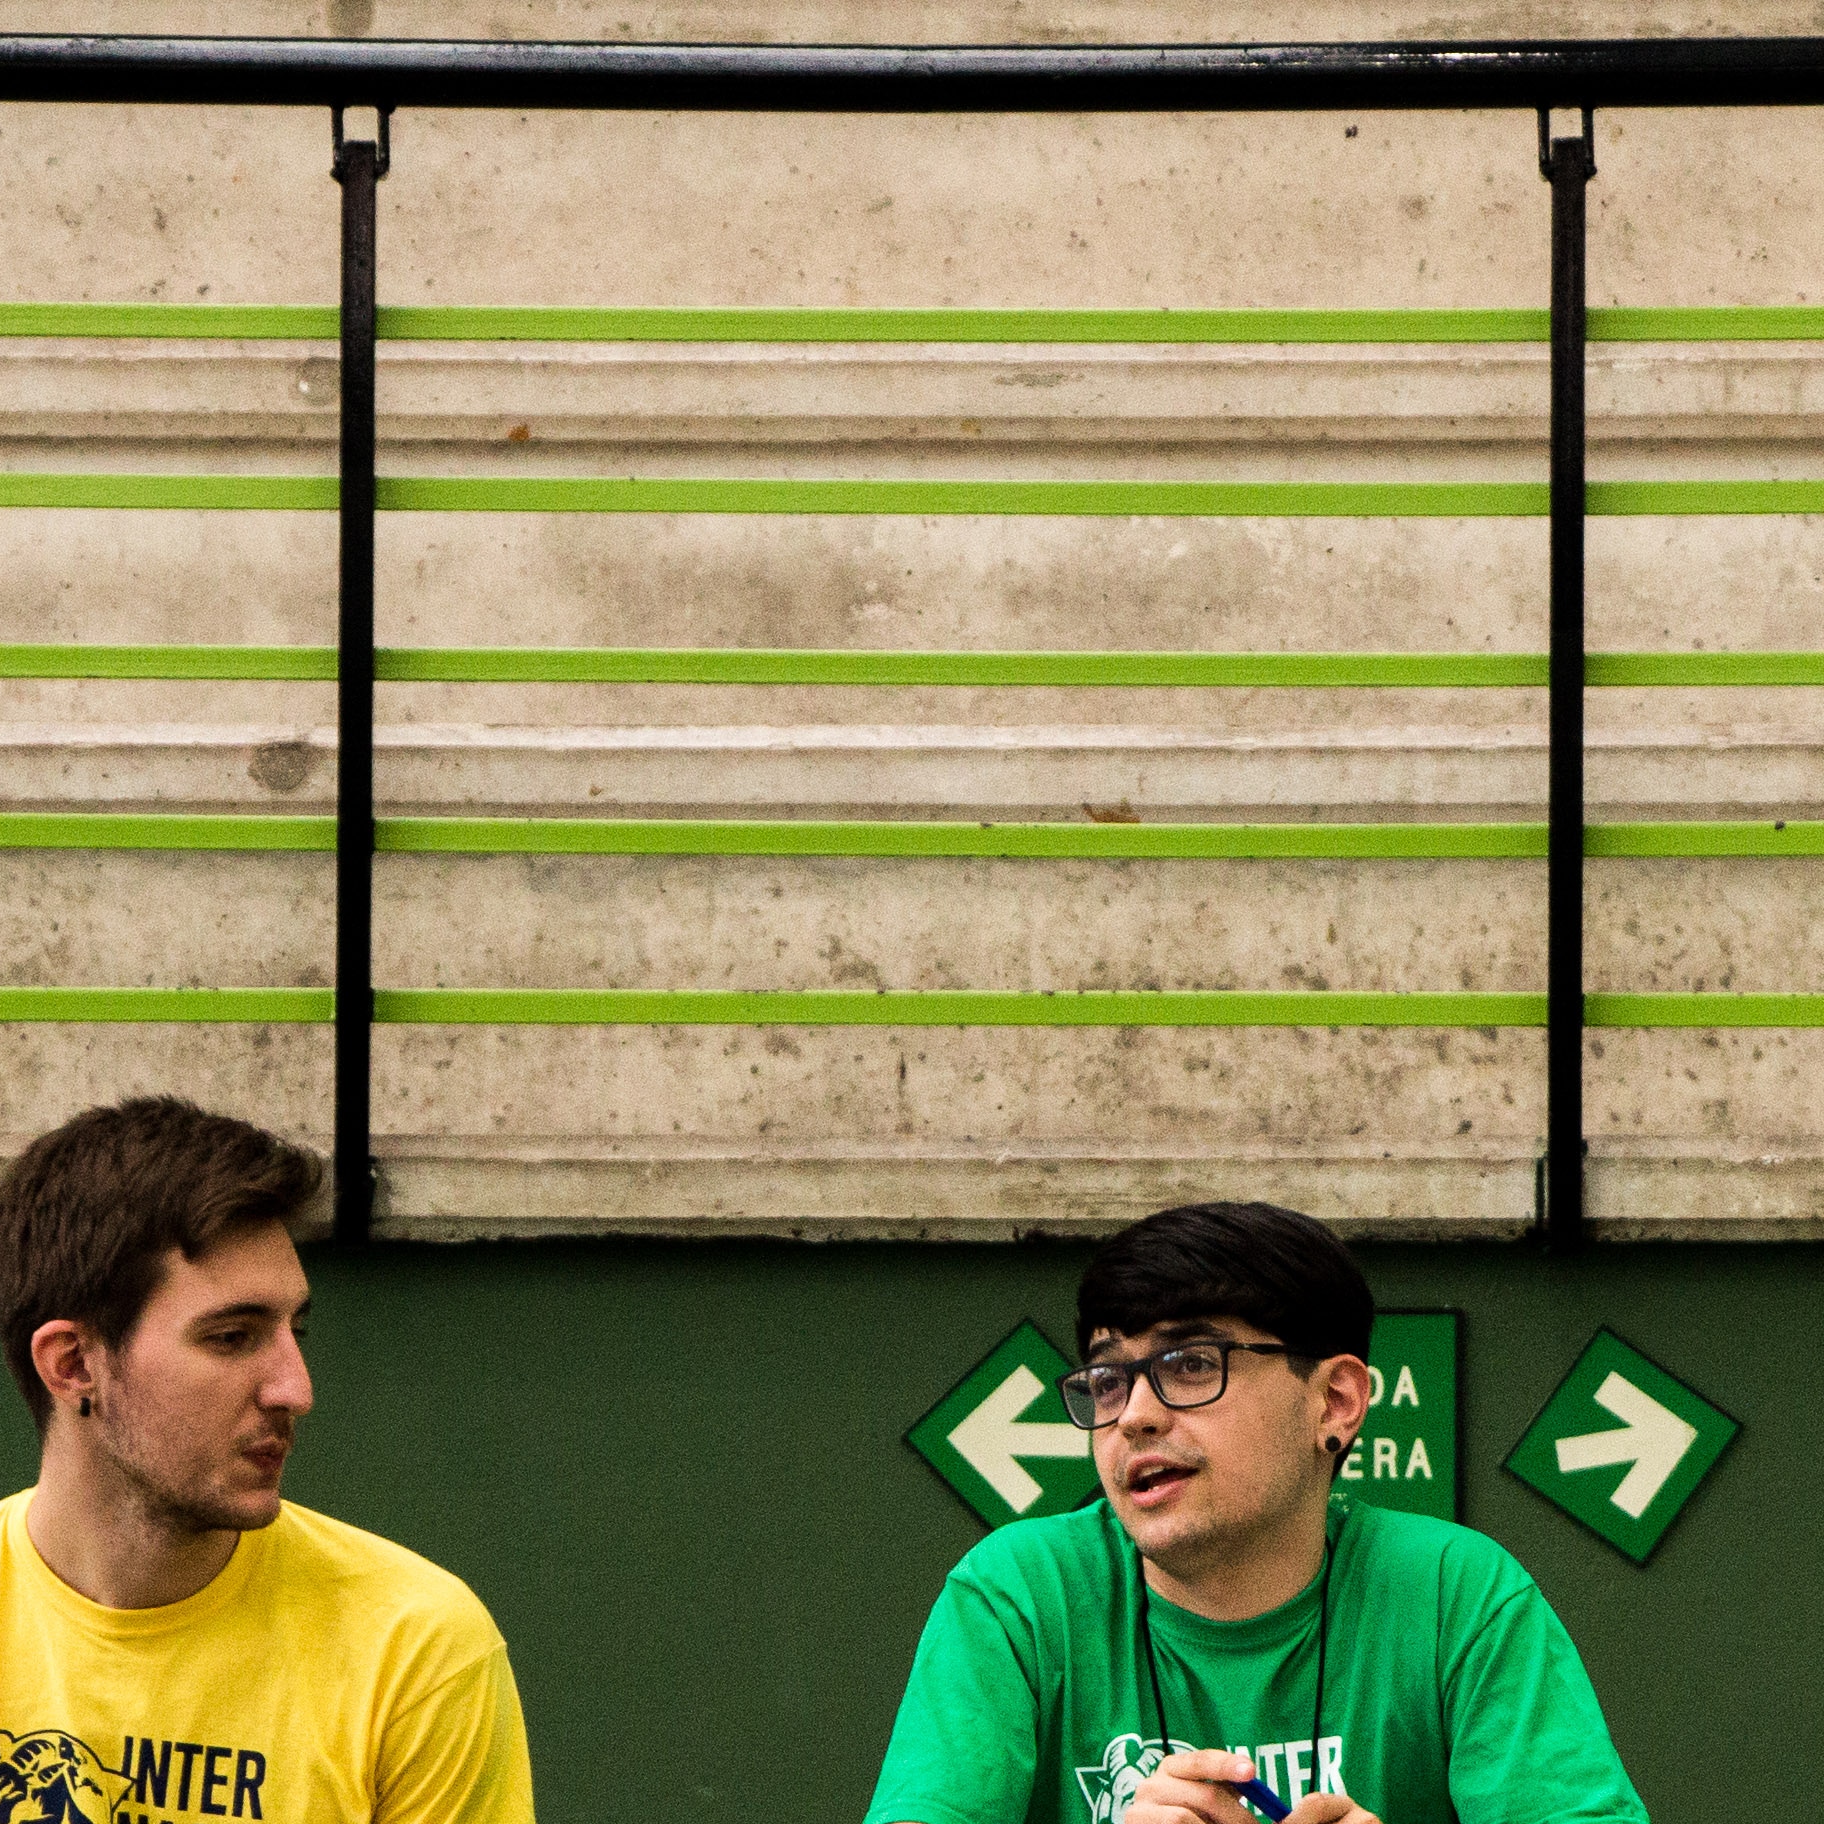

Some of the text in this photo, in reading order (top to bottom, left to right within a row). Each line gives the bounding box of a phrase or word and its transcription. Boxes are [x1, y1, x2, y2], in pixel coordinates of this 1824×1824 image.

[1367, 1364, 1420, 1407] DA
[1341, 1437, 1433, 1480] ERA
[120, 1735, 267, 1821] INTER
